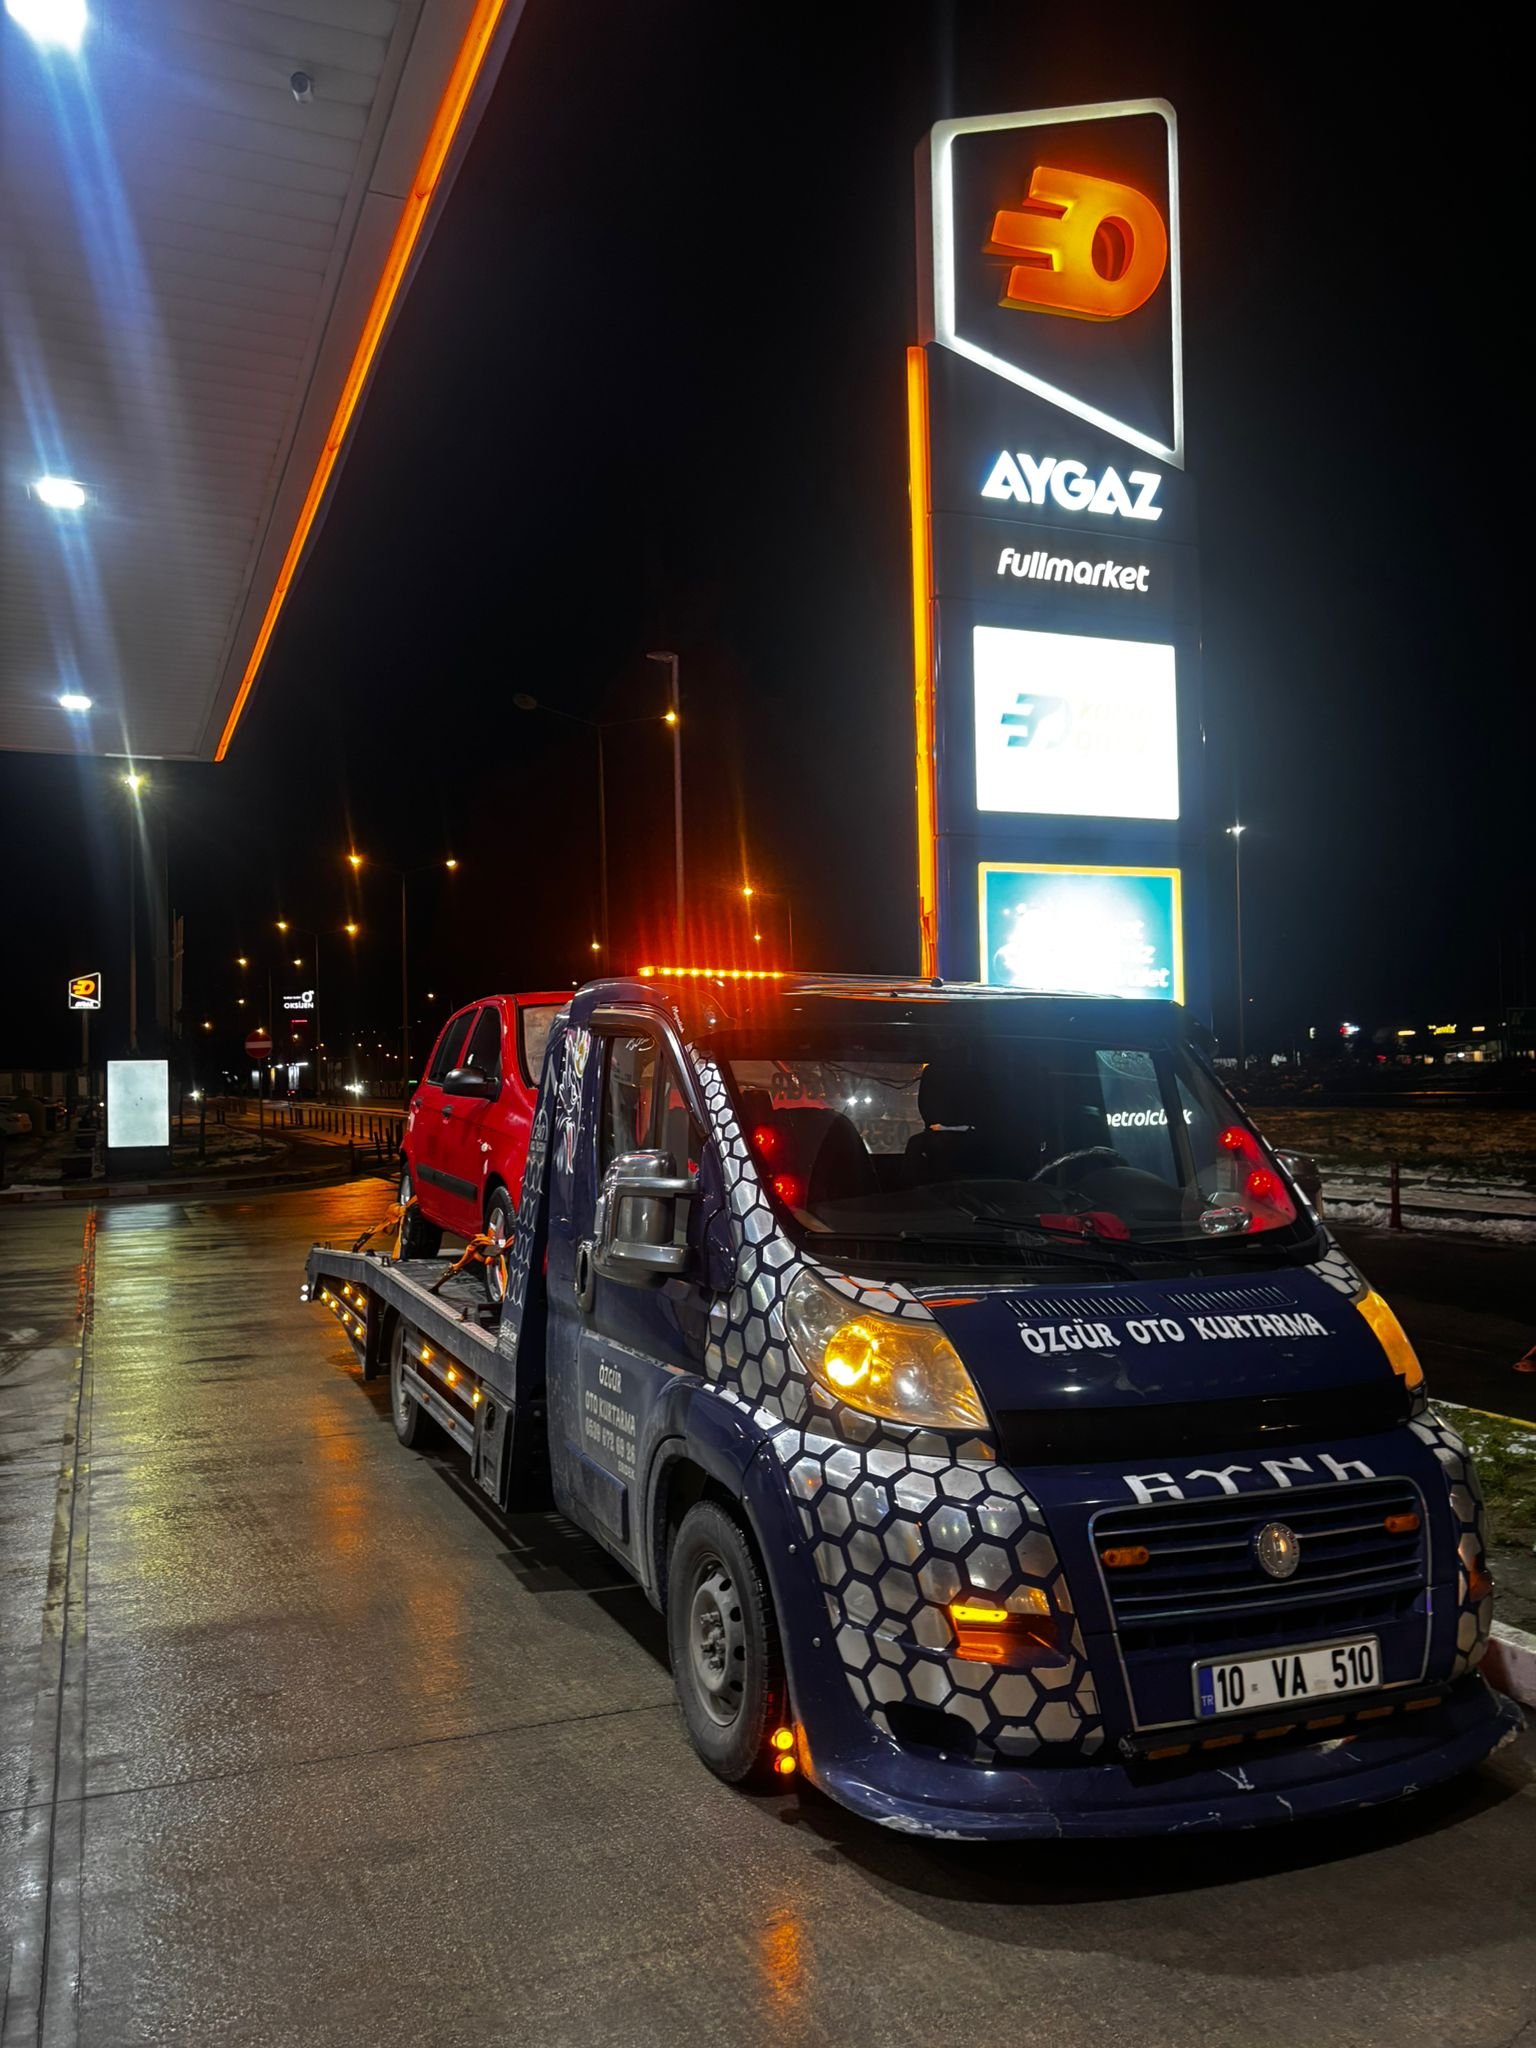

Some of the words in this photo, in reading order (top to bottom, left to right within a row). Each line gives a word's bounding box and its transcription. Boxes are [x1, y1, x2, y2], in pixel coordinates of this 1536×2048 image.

[981, 450, 1163, 521] AYGAZ
[1018, 1318, 1121, 1354] ÖZGÜR
[1126, 1318, 1185, 1345] OTO
[1189, 1312, 1329, 1341] KURTARMA
[1217, 1666, 1245, 1708] 10
[1272, 1656, 1308, 1699] VA
[1332, 1645, 1374, 1688] 510
